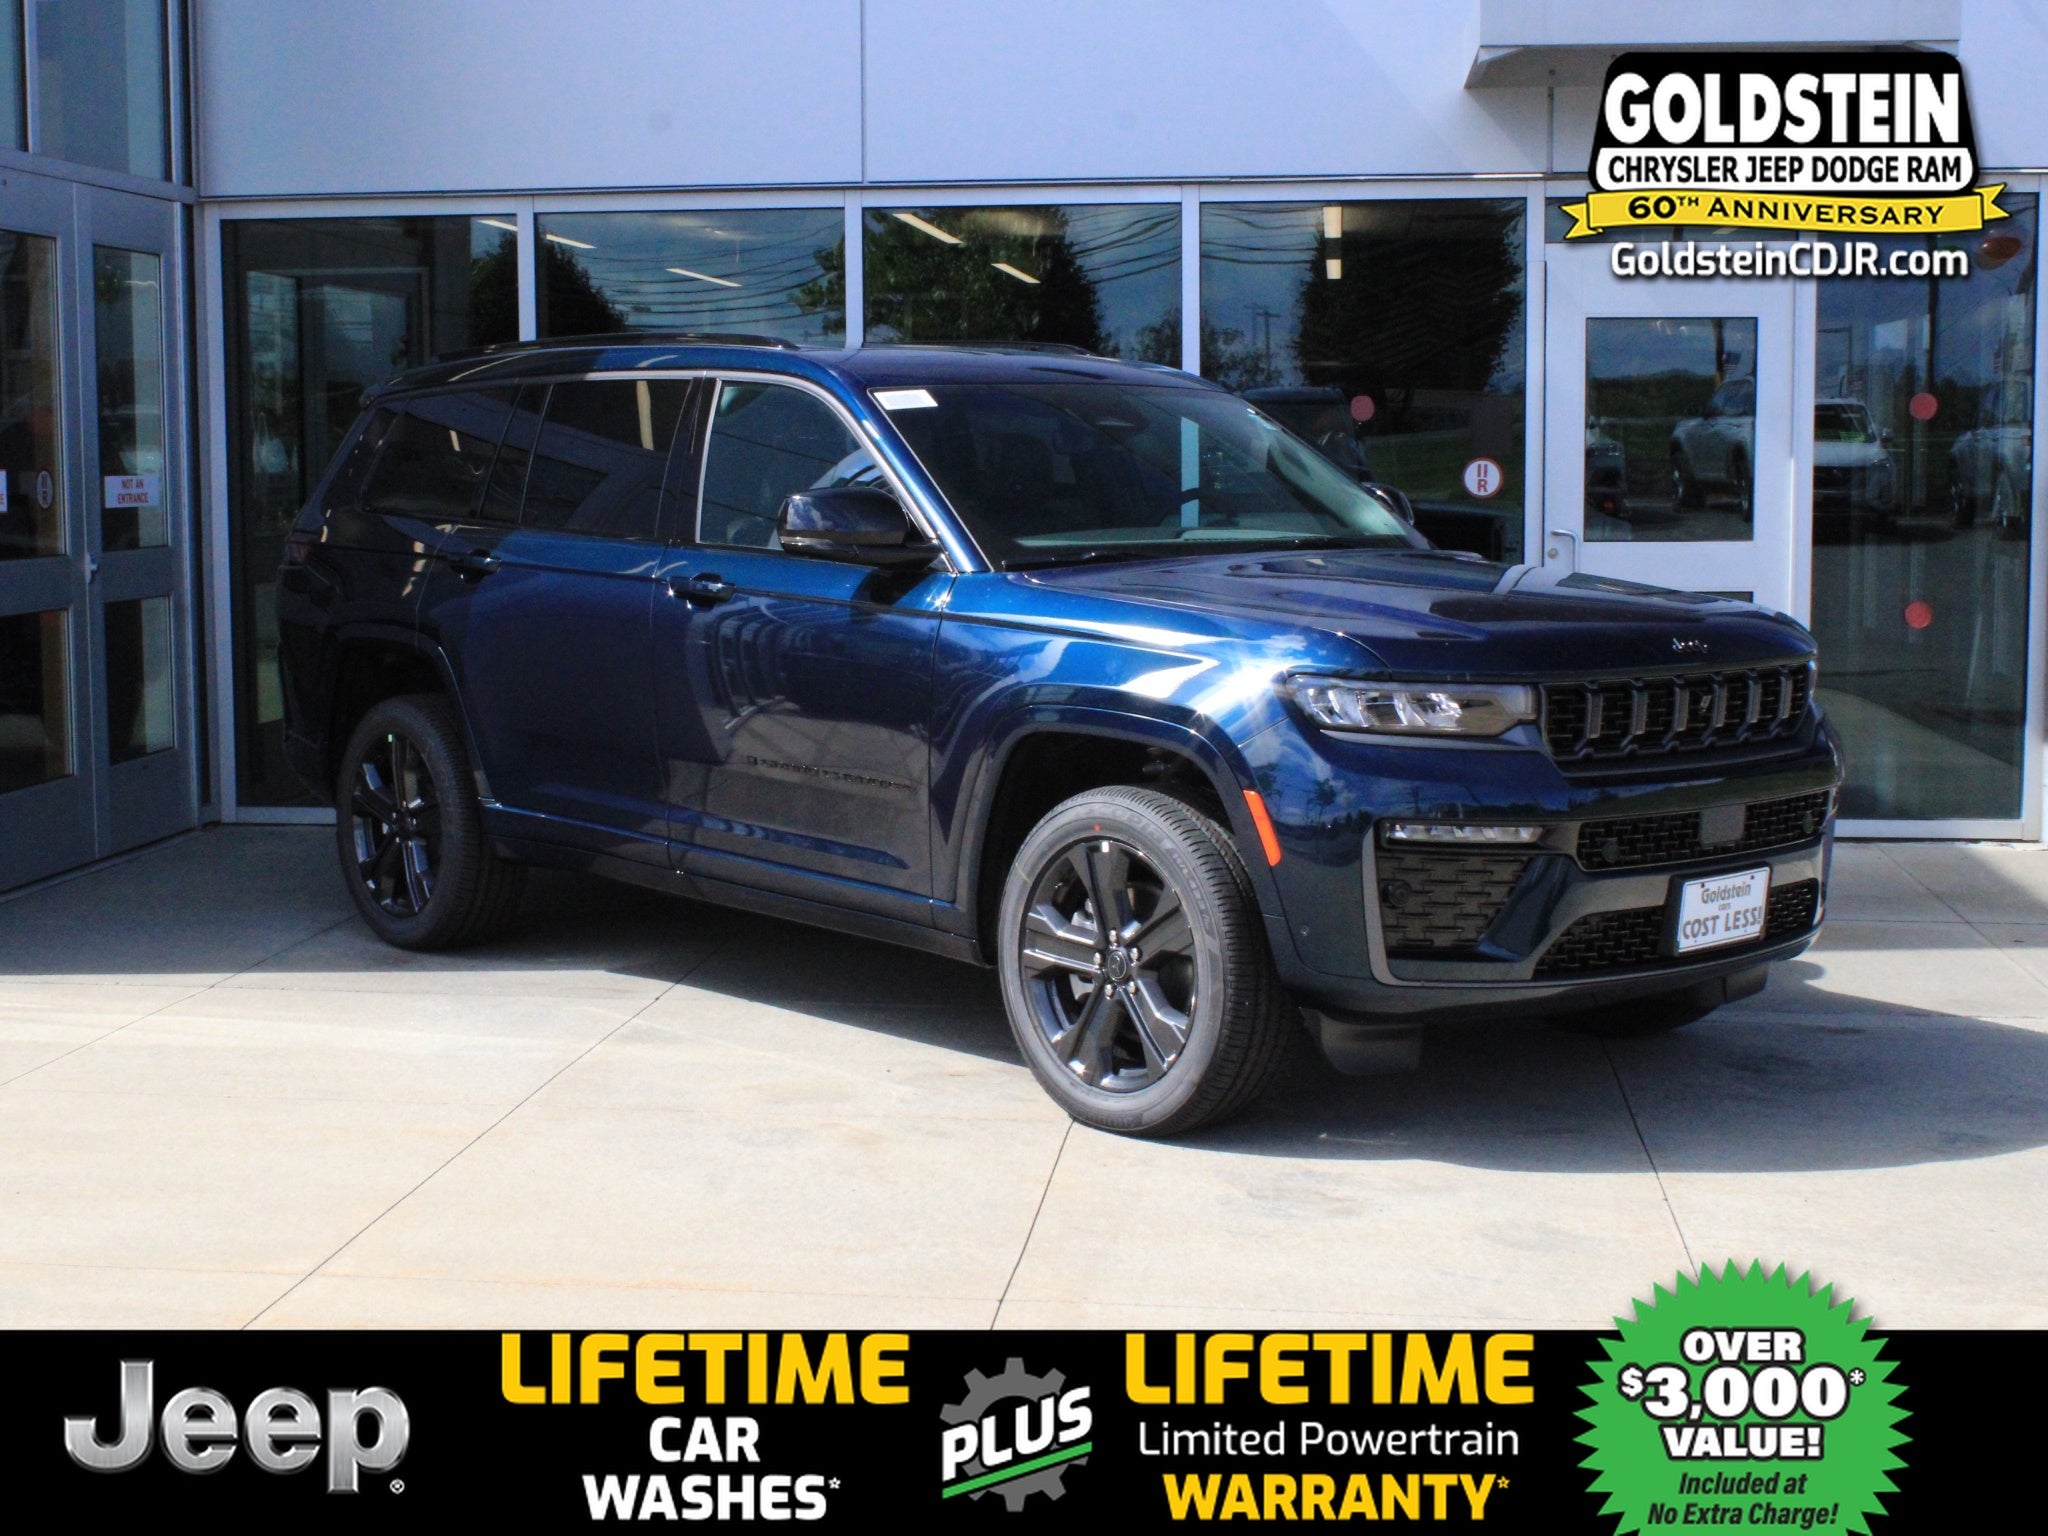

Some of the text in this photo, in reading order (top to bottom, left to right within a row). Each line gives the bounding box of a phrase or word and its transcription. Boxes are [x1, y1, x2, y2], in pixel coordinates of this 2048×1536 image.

[121, 479, 134, 489] NOT
[117, 492, 149, 504] ENTRANCE
[1701, 881, 1751, 904] Goldstein
[1682, 906, 1762, 940] COST LESS!
